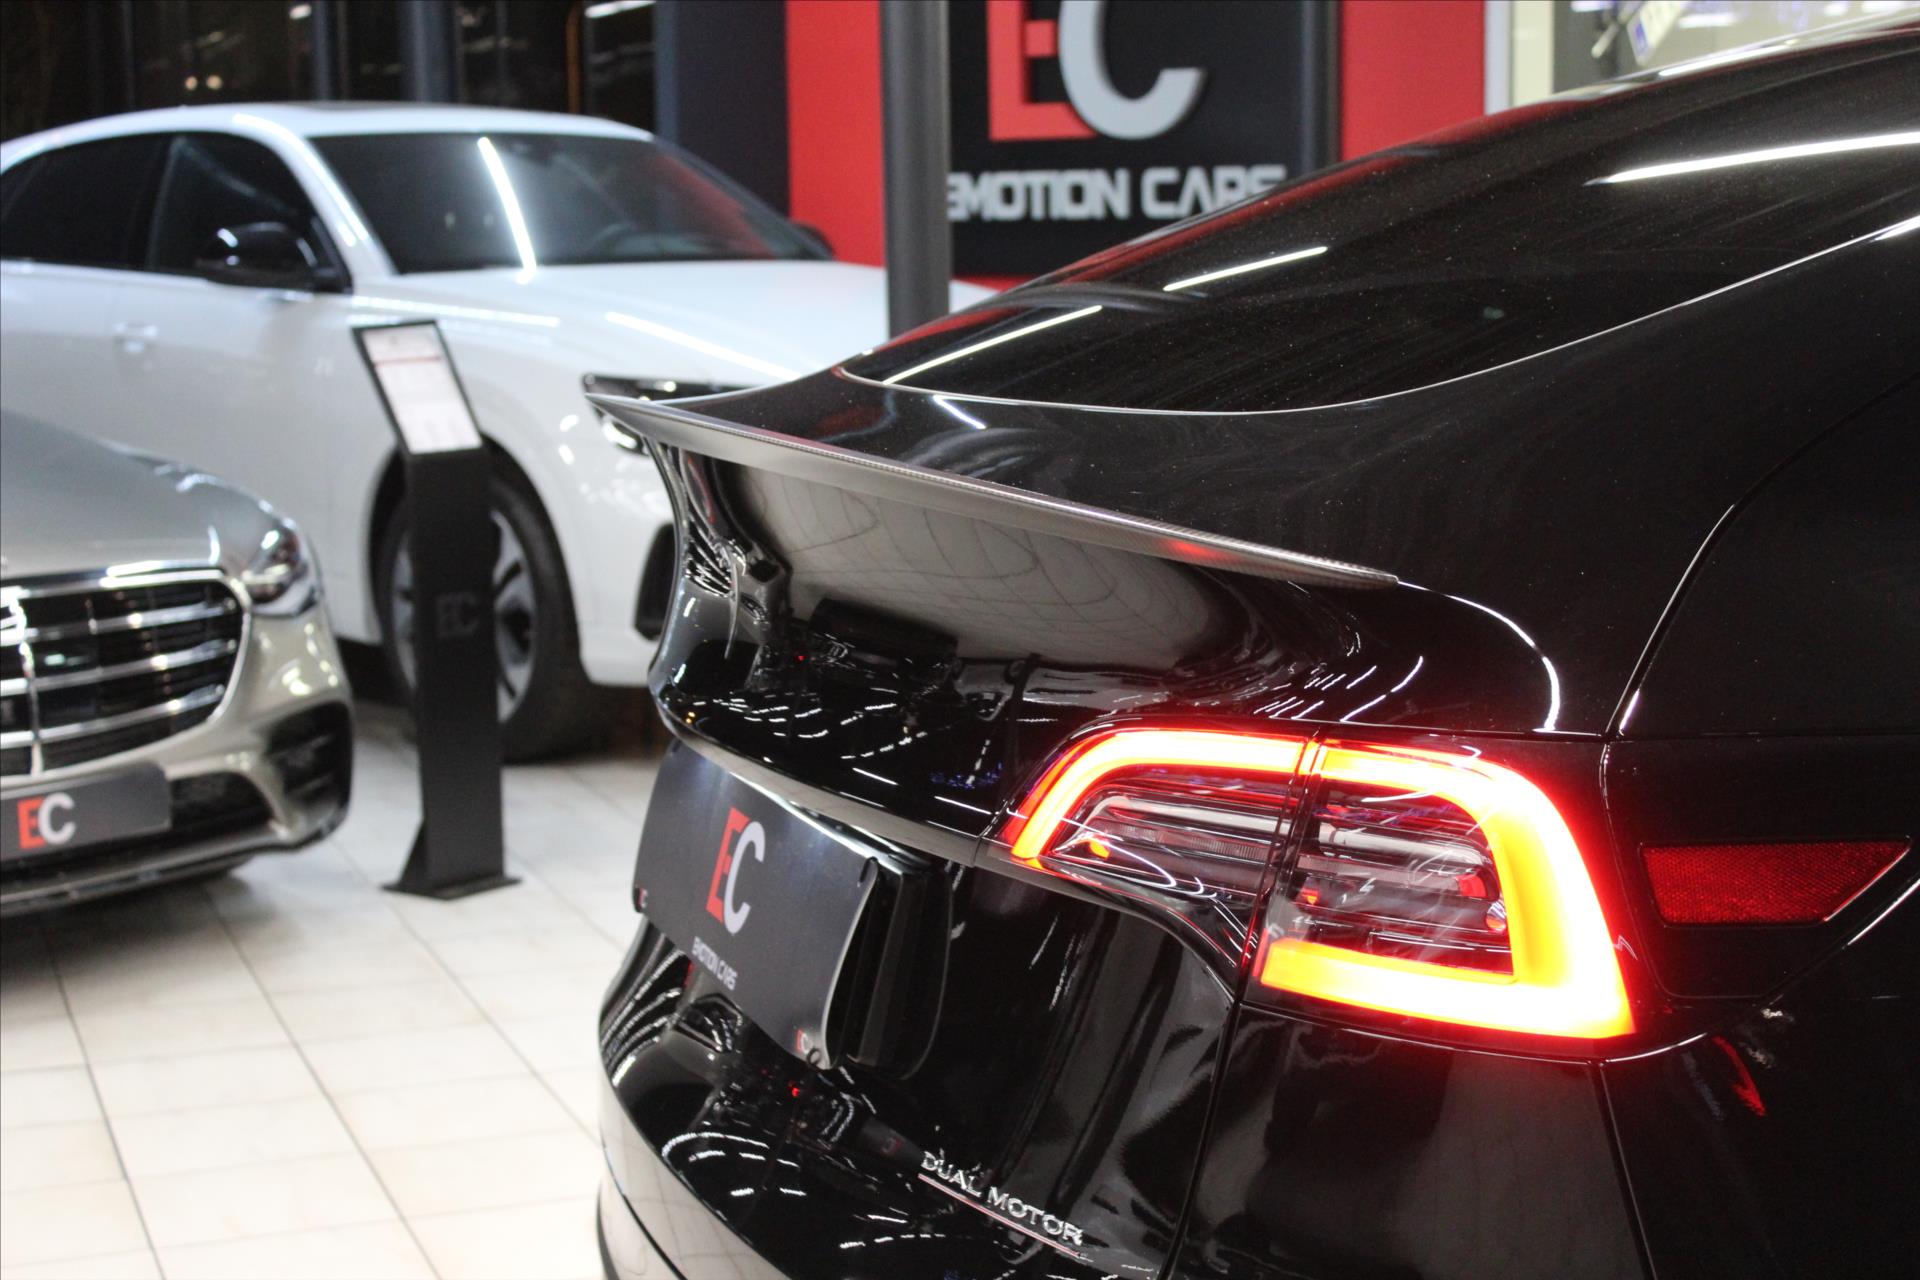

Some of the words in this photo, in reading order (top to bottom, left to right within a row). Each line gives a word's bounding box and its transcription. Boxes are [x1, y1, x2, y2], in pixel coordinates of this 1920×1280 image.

[17, 792, 76, 849] EC
[706, 806, 766, 936] EC
[920, 1151, 982, 1198] DUAL
[987, 1186, 1085, 1246] MOTOR
